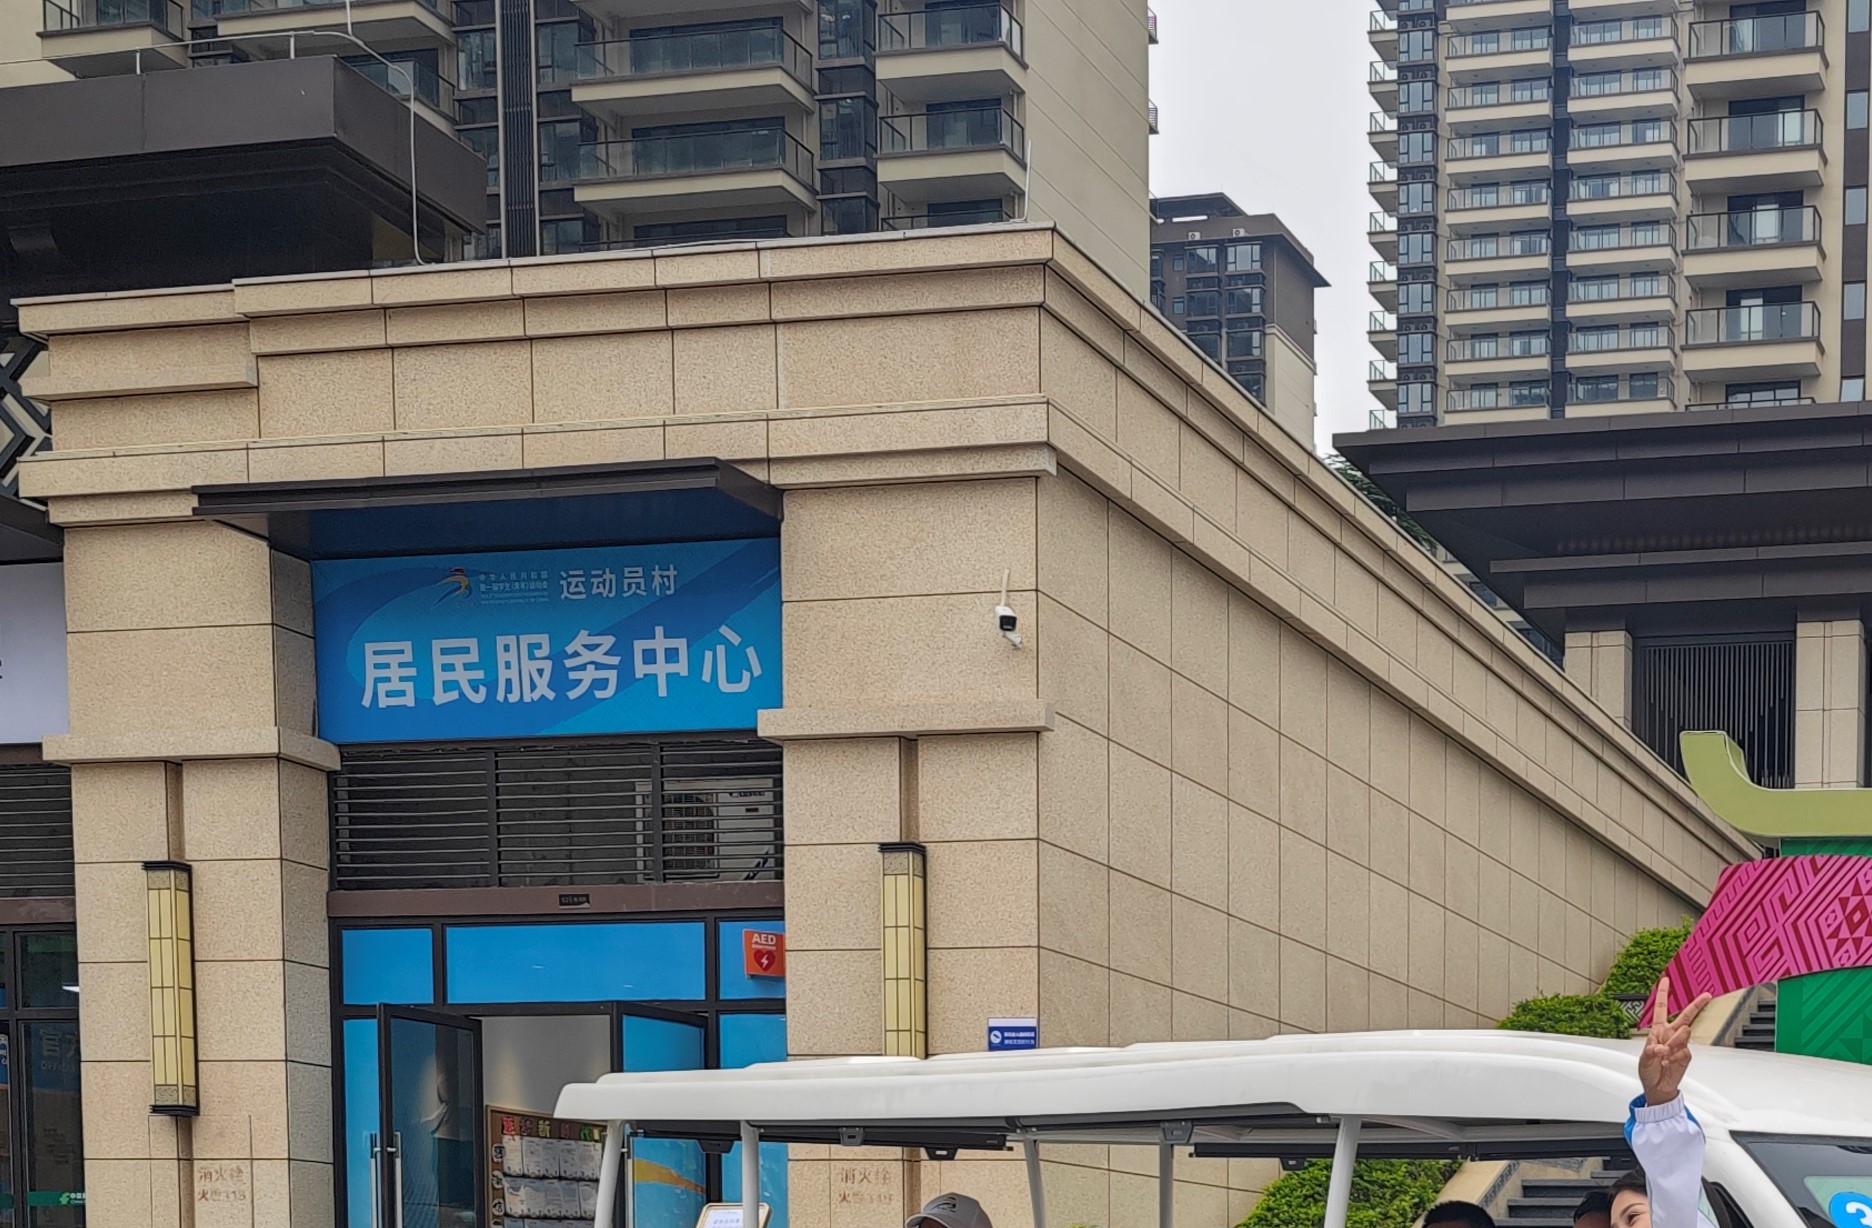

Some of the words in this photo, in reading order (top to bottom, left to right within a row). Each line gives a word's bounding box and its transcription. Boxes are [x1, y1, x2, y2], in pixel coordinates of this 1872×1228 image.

[560, 564, 677, 600] 运动员村
[361, 625, 762, 709] 居民服务中心
[752, 933, 776, 945] AED
